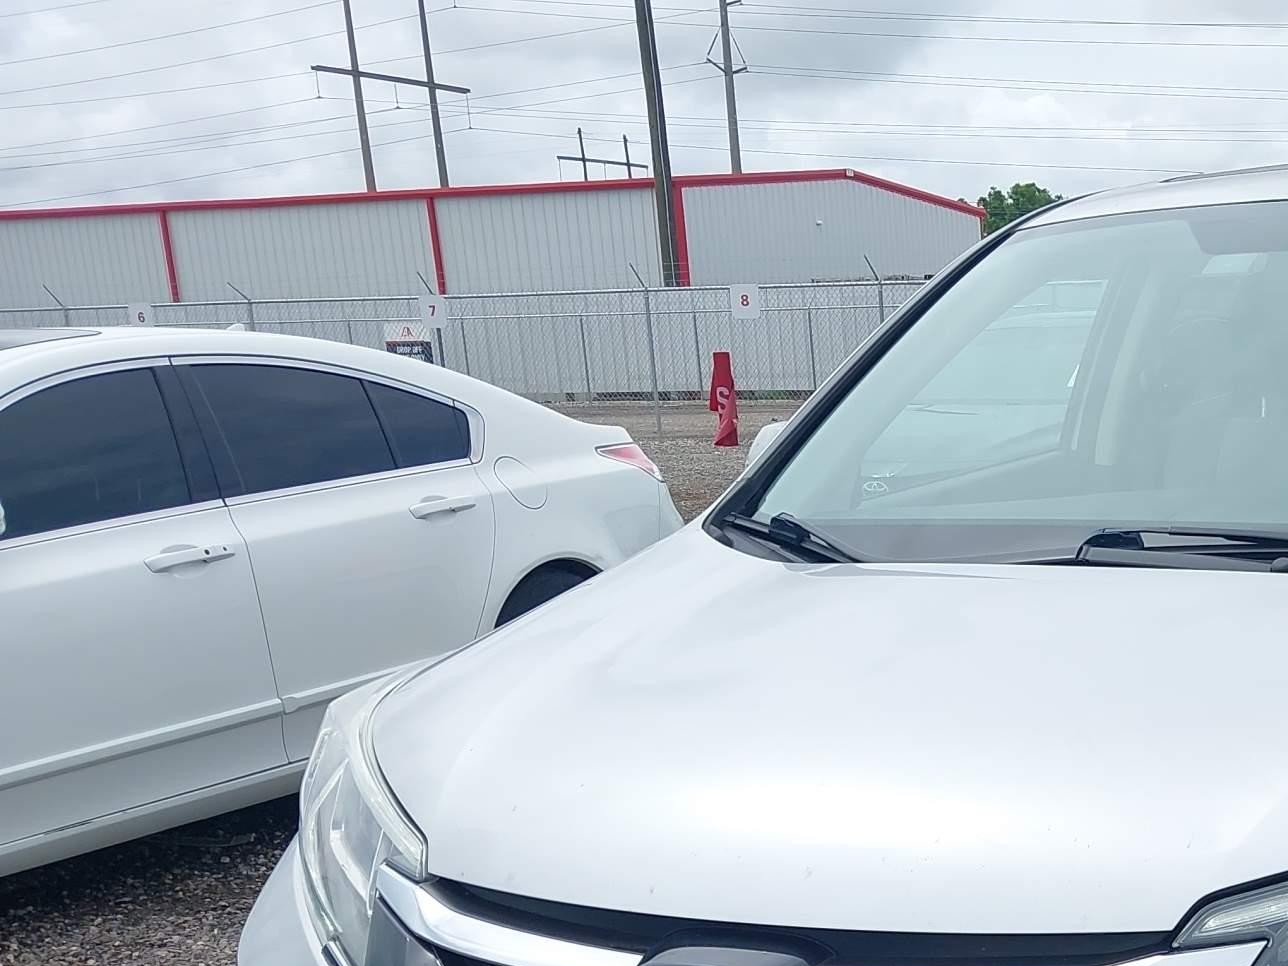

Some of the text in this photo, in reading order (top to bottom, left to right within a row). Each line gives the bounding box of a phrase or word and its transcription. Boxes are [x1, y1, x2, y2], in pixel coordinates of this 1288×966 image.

[740, 294, 750, 306] 8
[428, 304, 436, 316] 7
[137, 311, 145, 323] 6
